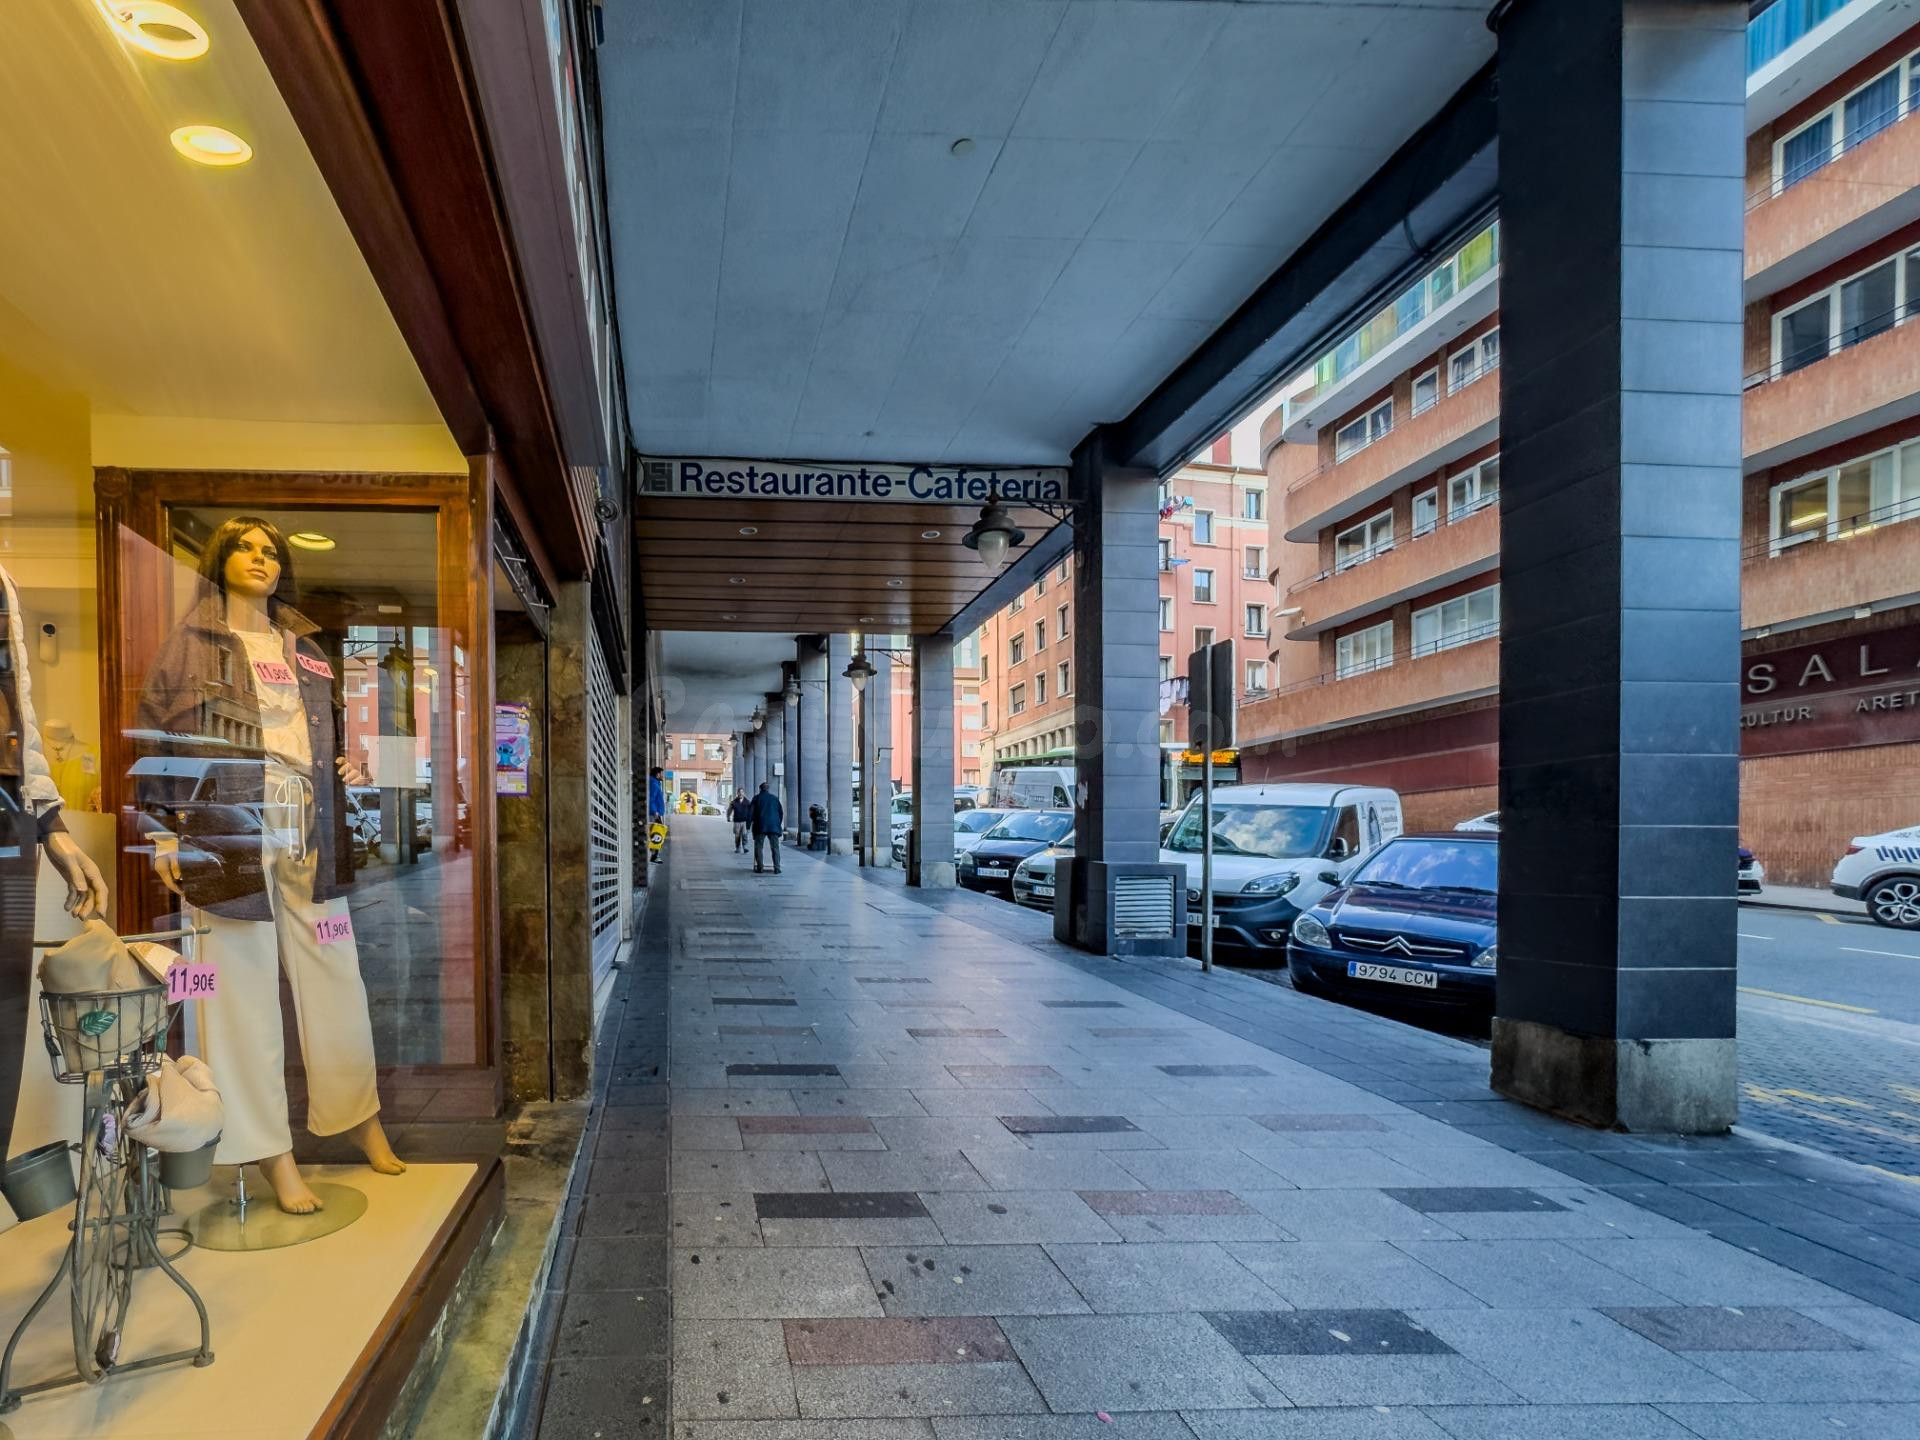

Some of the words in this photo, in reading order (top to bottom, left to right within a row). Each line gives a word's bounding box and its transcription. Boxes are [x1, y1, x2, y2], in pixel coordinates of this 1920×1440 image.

[680, 462, 1062, 501] Restaurante-Cafetería
[1747, 644, 1920, 695] SAL
[316, 920, 350, 940] 11,90€
[169, 967, 215, 996] 11,90€
[1358, 965, 1397, 981] 9794
[1404, 971, 1434, 987] CCM
